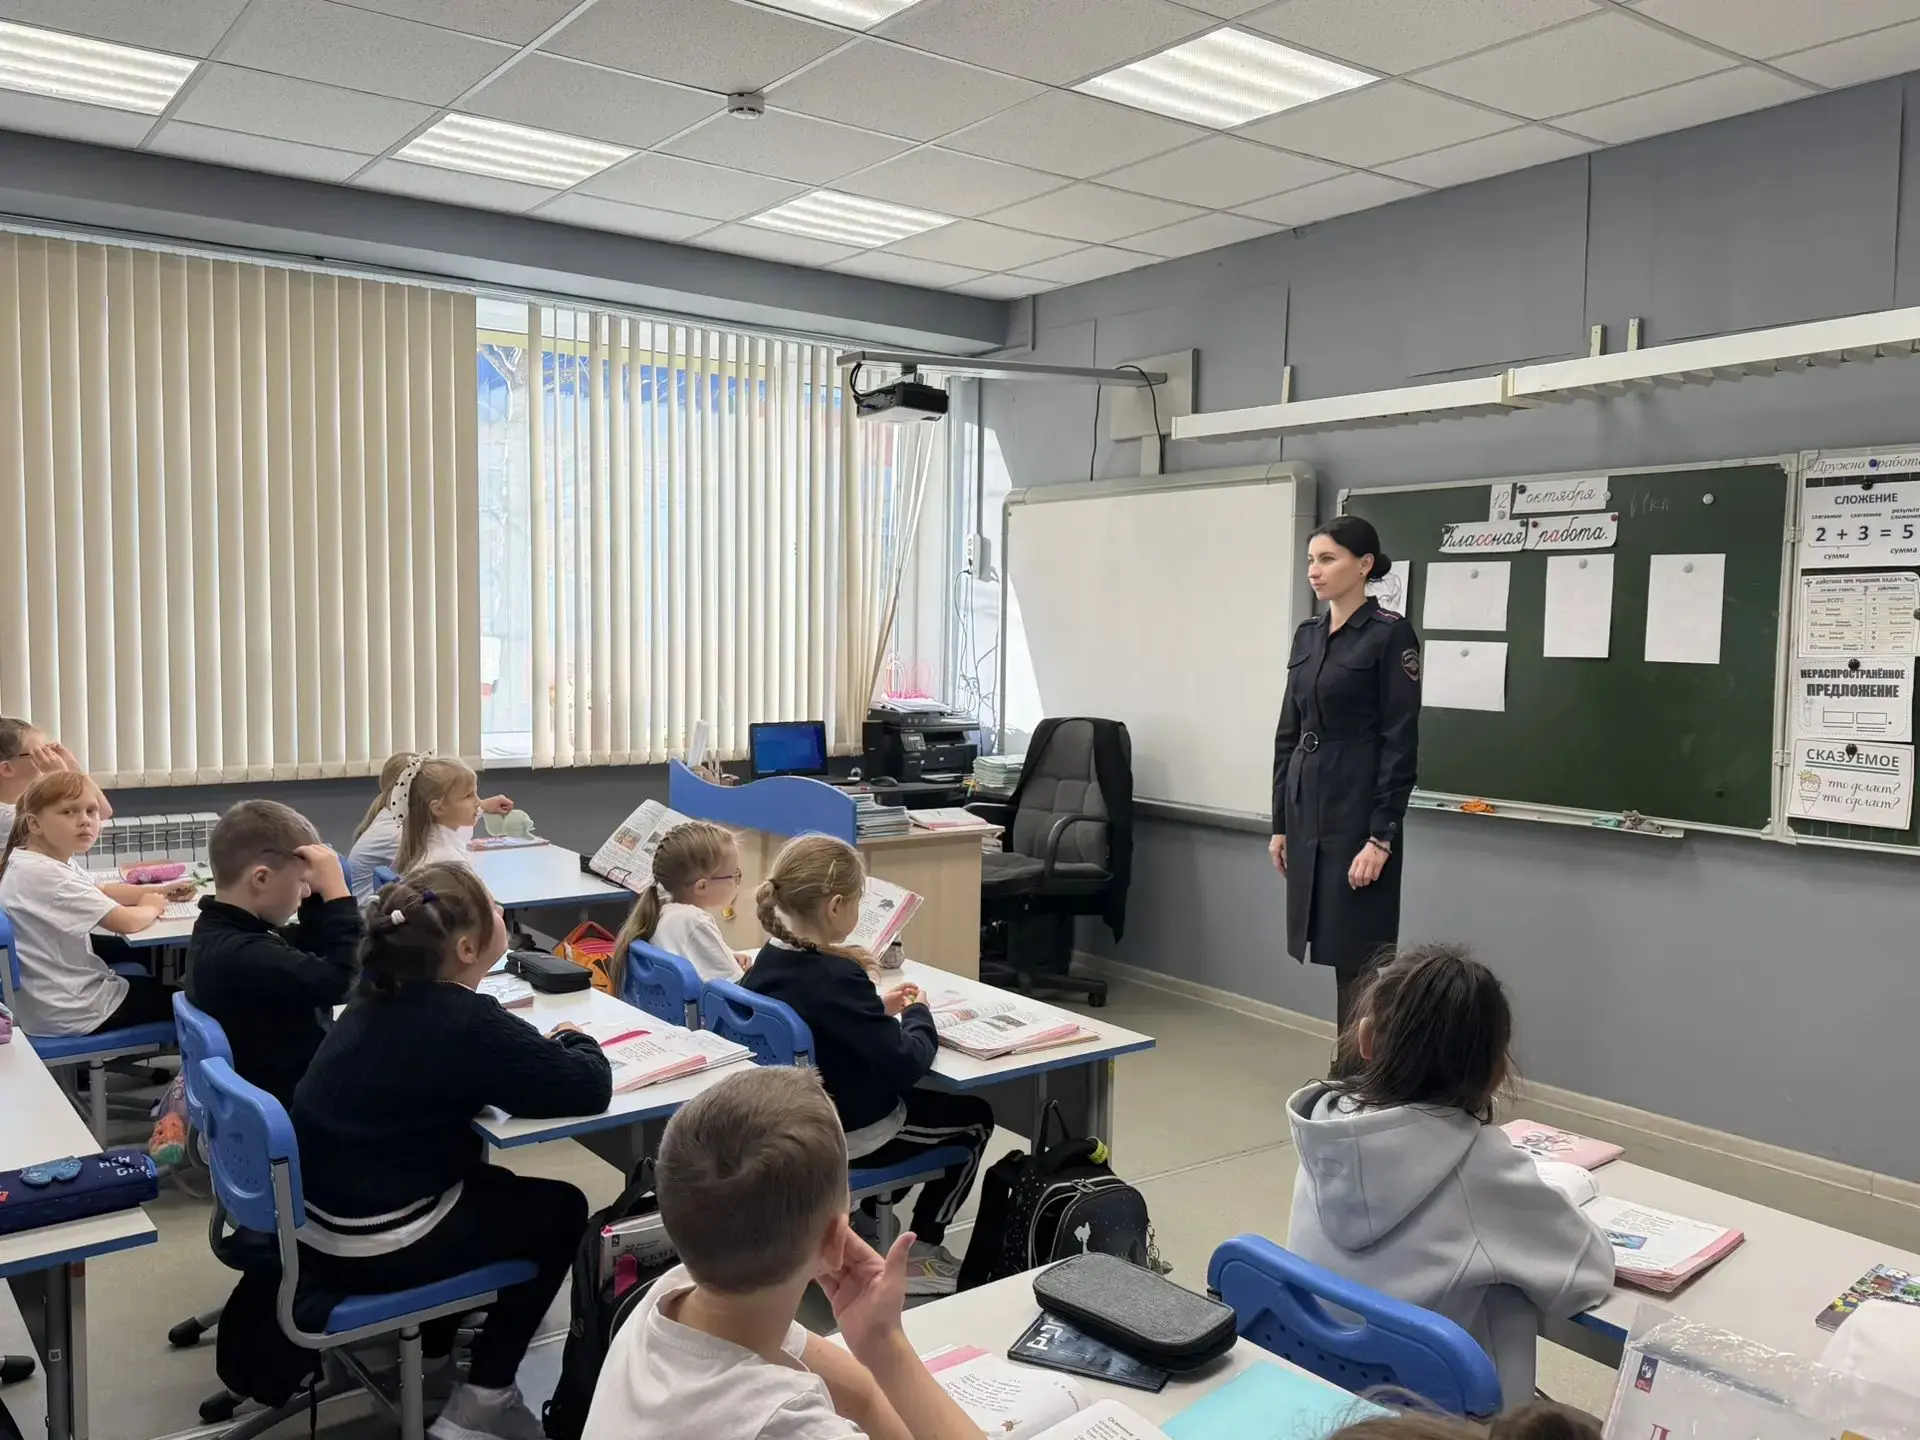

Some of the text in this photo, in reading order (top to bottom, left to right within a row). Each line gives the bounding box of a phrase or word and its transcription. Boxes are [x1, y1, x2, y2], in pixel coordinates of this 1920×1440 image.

[1876, 456, 1920, 471] работ
[1493, 481, 1597, 509] 12 октября
[1834, 493, 1898, 505] СЛОЖЕНИЕ
[1444, 516, 1608, 549] Классная работа.
[1815, 523, 1914, 542] 2 + 3 = 5
[1823, 552, 1850, 561] сумма
[1890, 546, 1918, 555] сумма
[1800, 668, 1905, 680] НЕРАСПРОСТРАНЁННОЕ
[1806, 683, 1900, 699] ПРЕДЛОЖЕНИЕ
[1806, 748, 1900, 768] СКАЗУЕМОЕ
[1828, 780, 1901, 797] что делает?
[1822, 793, 1900, 813] что сделает?
